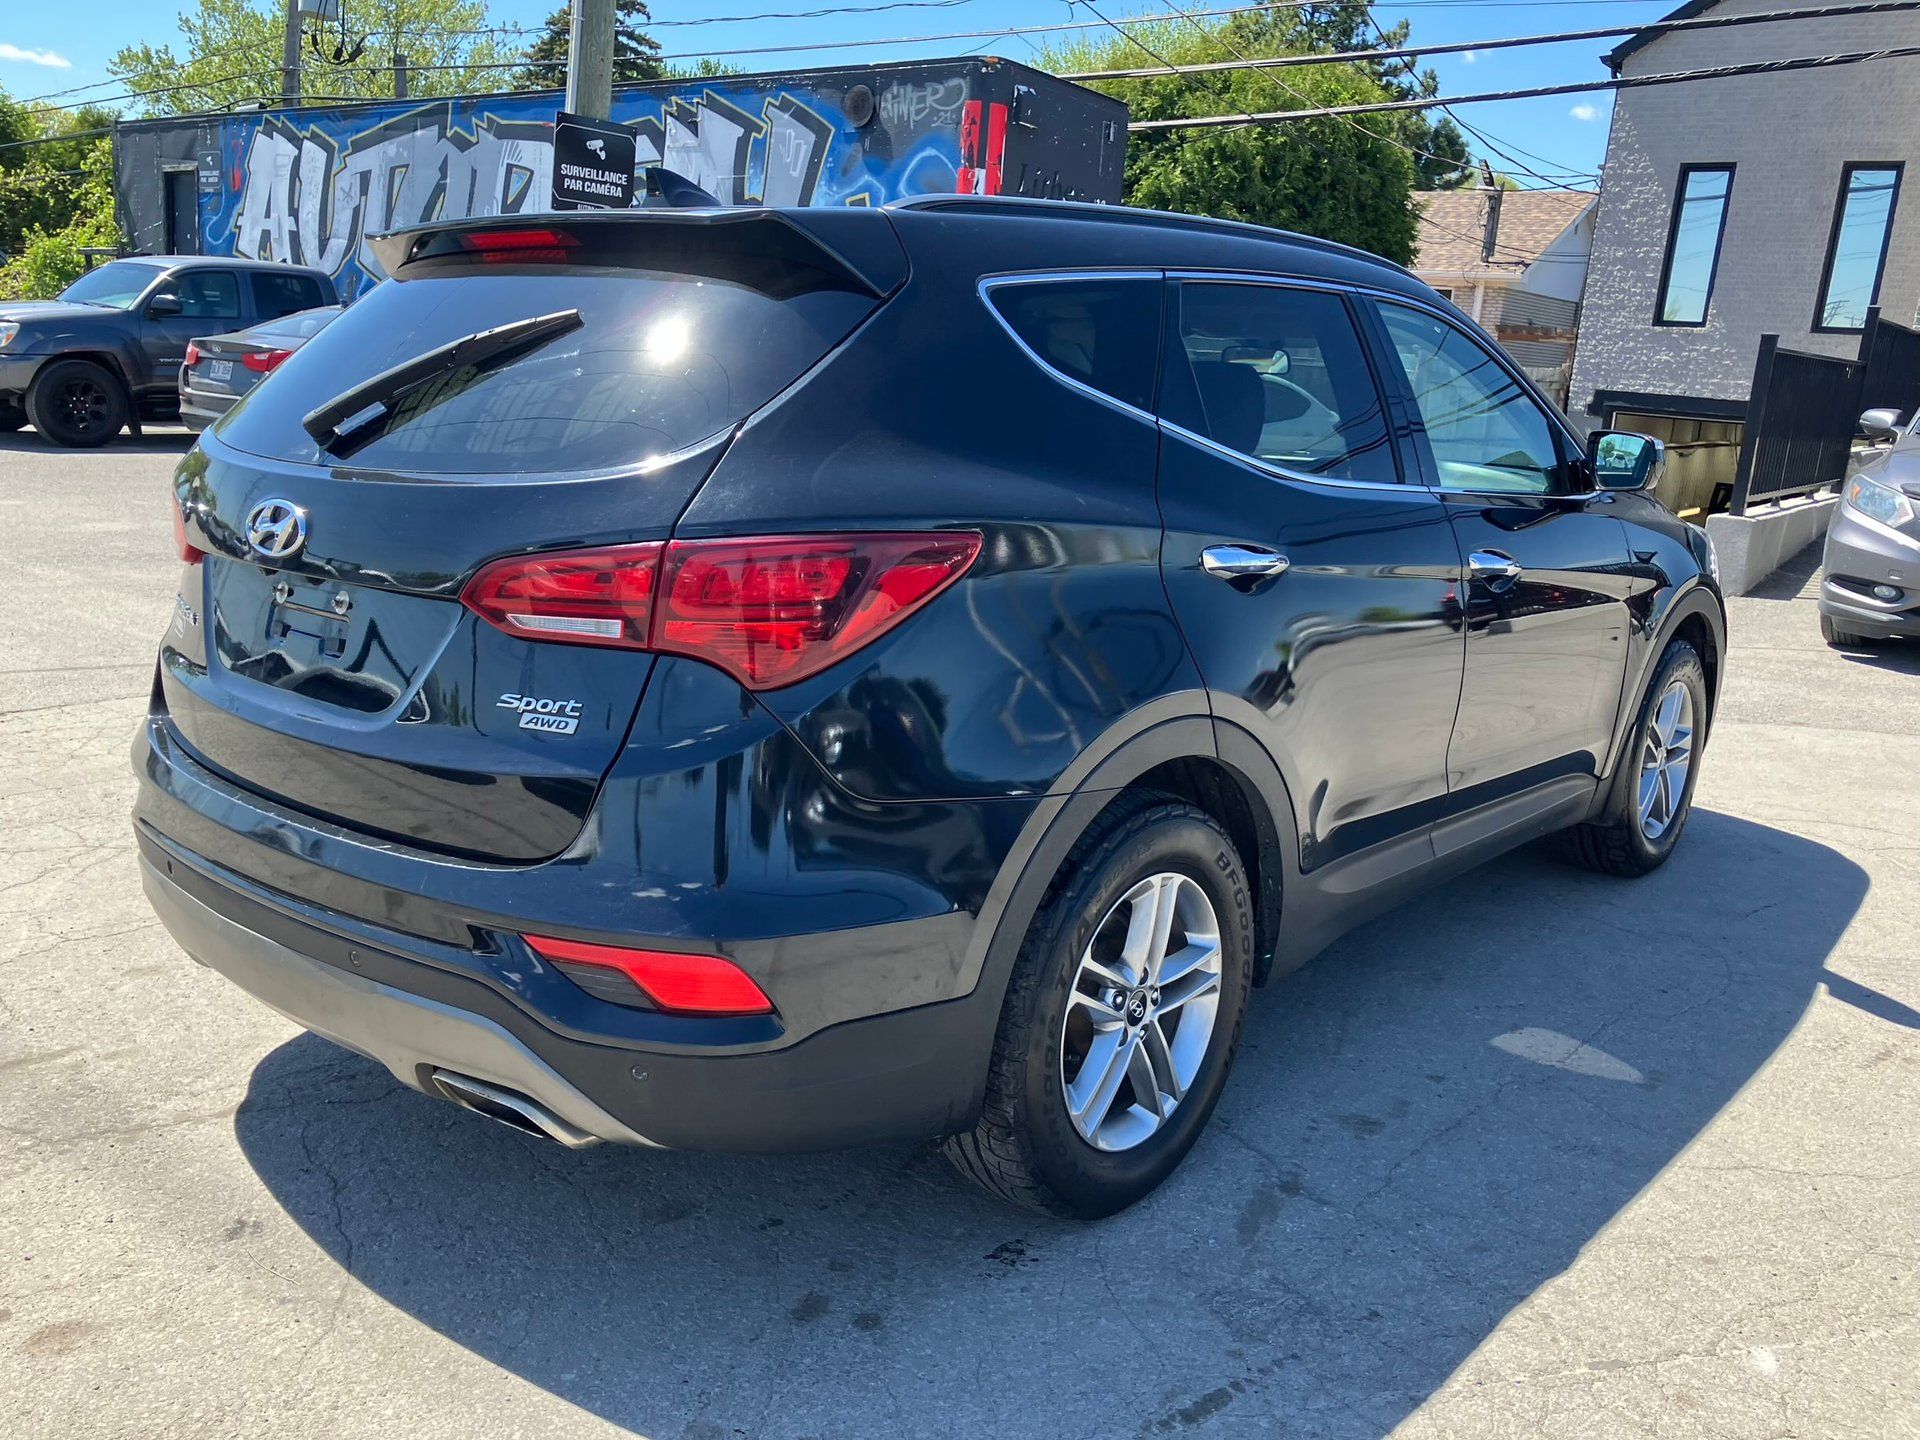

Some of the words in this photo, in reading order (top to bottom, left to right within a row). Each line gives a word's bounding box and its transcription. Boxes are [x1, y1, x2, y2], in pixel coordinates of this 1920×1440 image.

[560, 163, 628, 185] SURVEILLANCE
[564, 178, 582, 191] PAR
[584, 181, 622, 198] CAMÉRA
[496, 693, 582, 716] Sport
[524, 715, 571, 731] AWD
